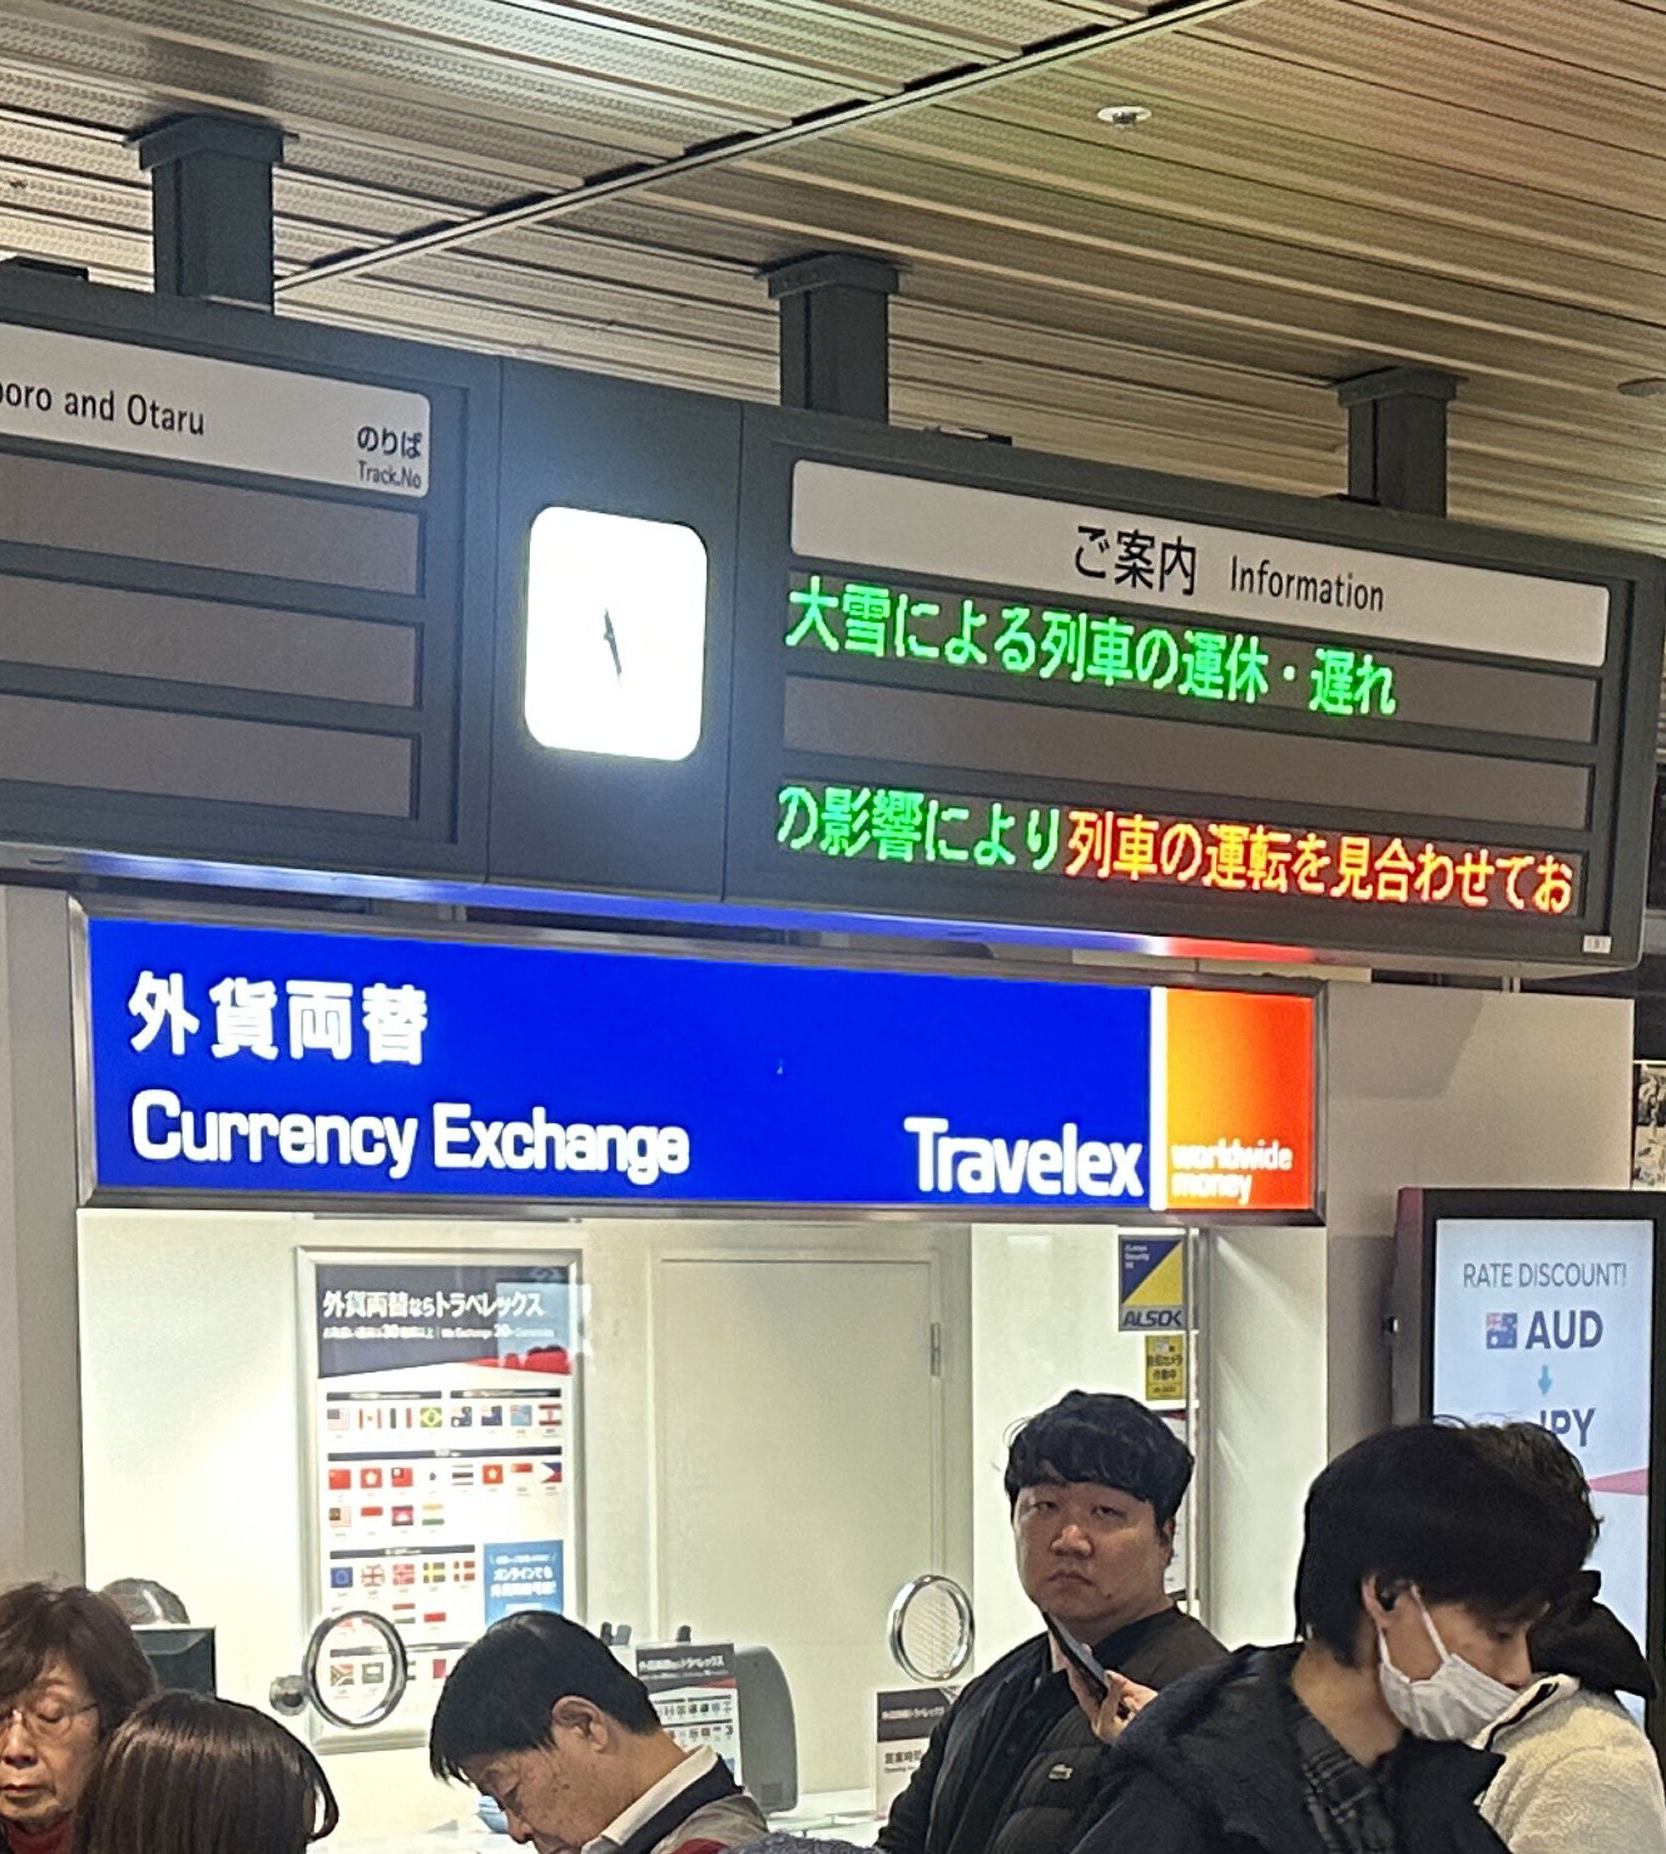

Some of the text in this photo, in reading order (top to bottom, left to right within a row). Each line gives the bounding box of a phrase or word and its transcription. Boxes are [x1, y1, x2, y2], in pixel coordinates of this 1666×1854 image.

[64, 387, 115, 423] and
[127, 394, 205, 437] Otaru
[357, 425, 423, 460] のりば
[1073, 523, 1198, 597] ご案内
[1230, 554, 1385, 613] Information
[785, 575, 1397, 716] 大雪による列車の運休・遅れ
[777, 784, 1574, 914] の影響により列車の運転を見合わせてお
[129, 970, 429, 1066] 外貨両替
[130, 1088, 691, 1185] Currency Exchange
[904, 1115, 1144, 1199] Travelex
[1170, 1138, 1293, 1171] worldwide
[1171, 1172, 1253, 1207] money
[1463, 1262, 1628, 1288] RATE DISCOUNT!
[322, 1288, 548, 1319] 外貨両替ならトラベレックス
[1122, 1309, 1183, 1328] ALSOK
[1524, 1309, 1604, 1350] AUD
